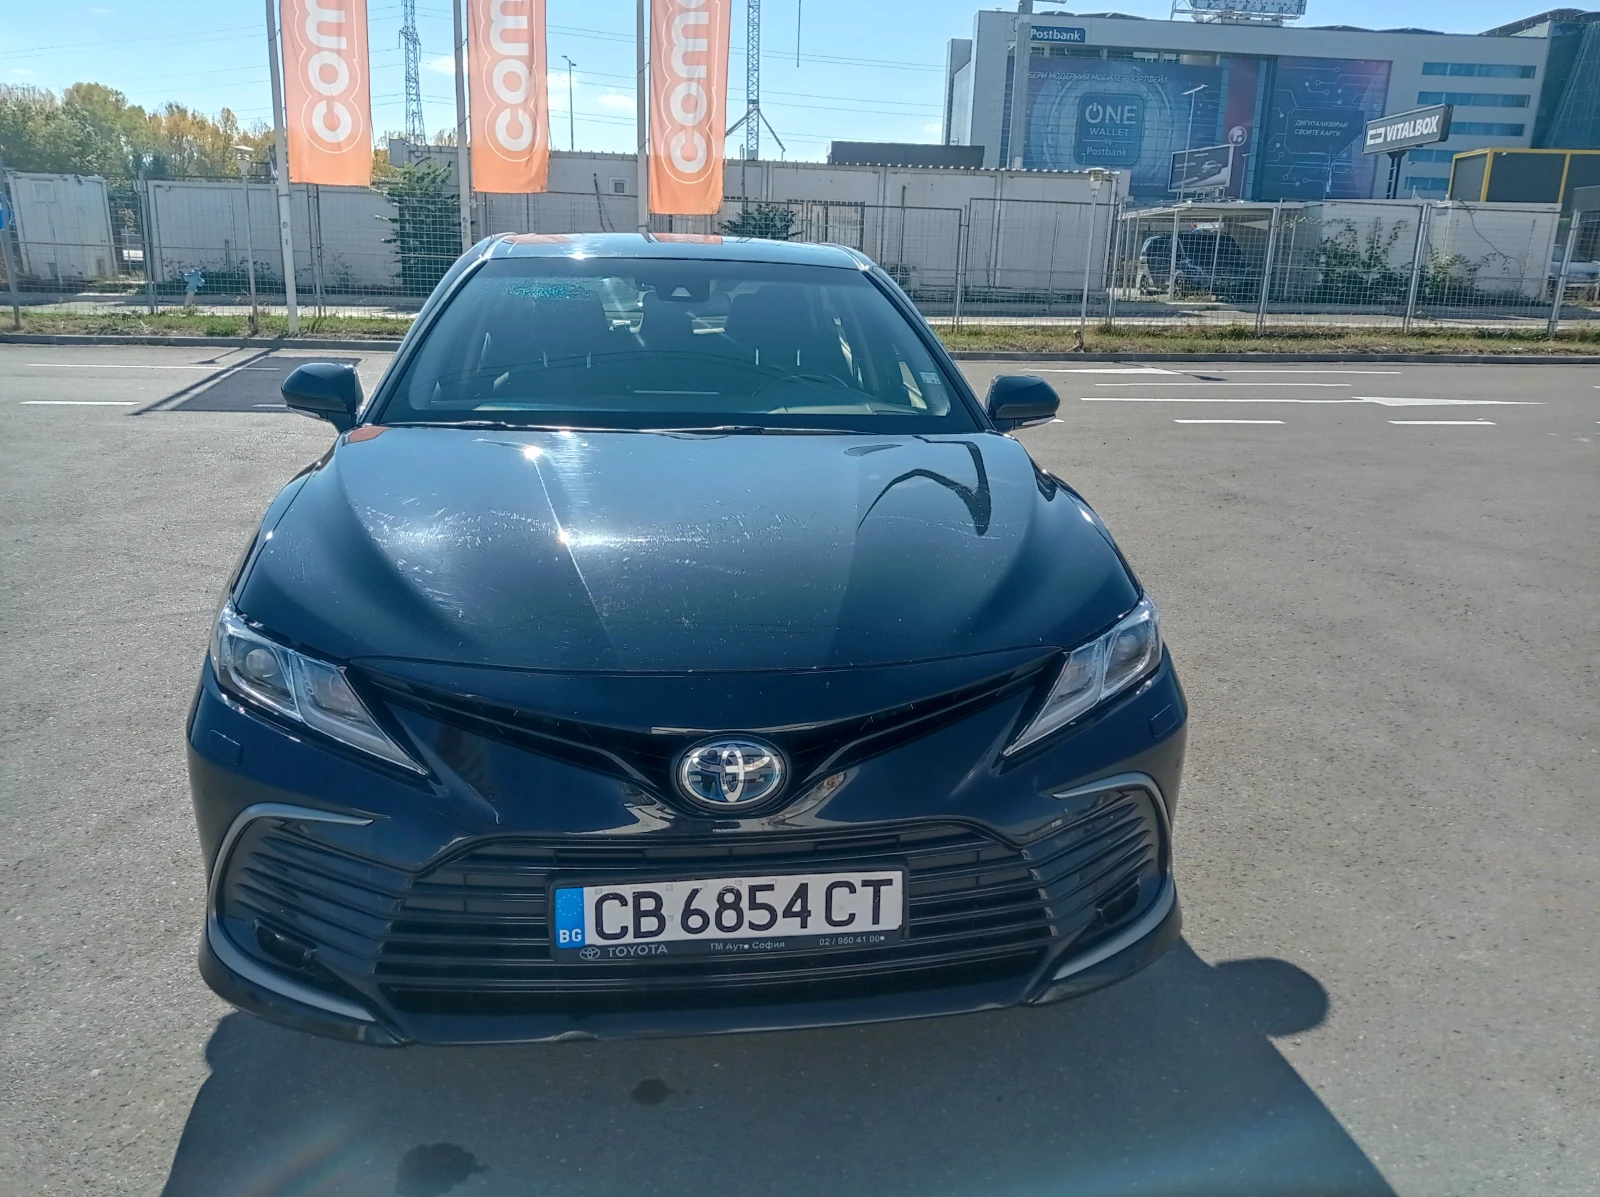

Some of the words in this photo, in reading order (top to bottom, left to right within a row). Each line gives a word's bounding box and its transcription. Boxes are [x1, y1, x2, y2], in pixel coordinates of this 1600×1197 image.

[1031, 28, 1081, 41] Postbank
[1048, 72, 1090, 81] МОДЕРНИЯ
[1091, 73, 1128, 82] МОБИЛЕН
[1128, 74, 1168, 84] ПОРТФЕЙЛ
[670, 0, 710, 174] com
[1085, 102, 1138, 125] ONE
[1295, 119, 1349, 128] ДИГИТАЛИЗИРАЙ
[1386, 115, 1440, 142] VITALBOX
[1090, 127, 1130, 137] WALLET
[1294, 128, 1320, 136] СВОИТЕ
[1086, 146, 1128, 157] Postbank
[680, 882, 812, 935] 6854
[824, 878, 894, 927] CT
[559, 928, 583, 943] BG
[819, 937, 830, 946] 02
[837, 936, 854, 945] 960
[855, 935, 867, 944] 41
[607, 944, 668, 958] TOYOTA
[751, 940, 786, 951] София
